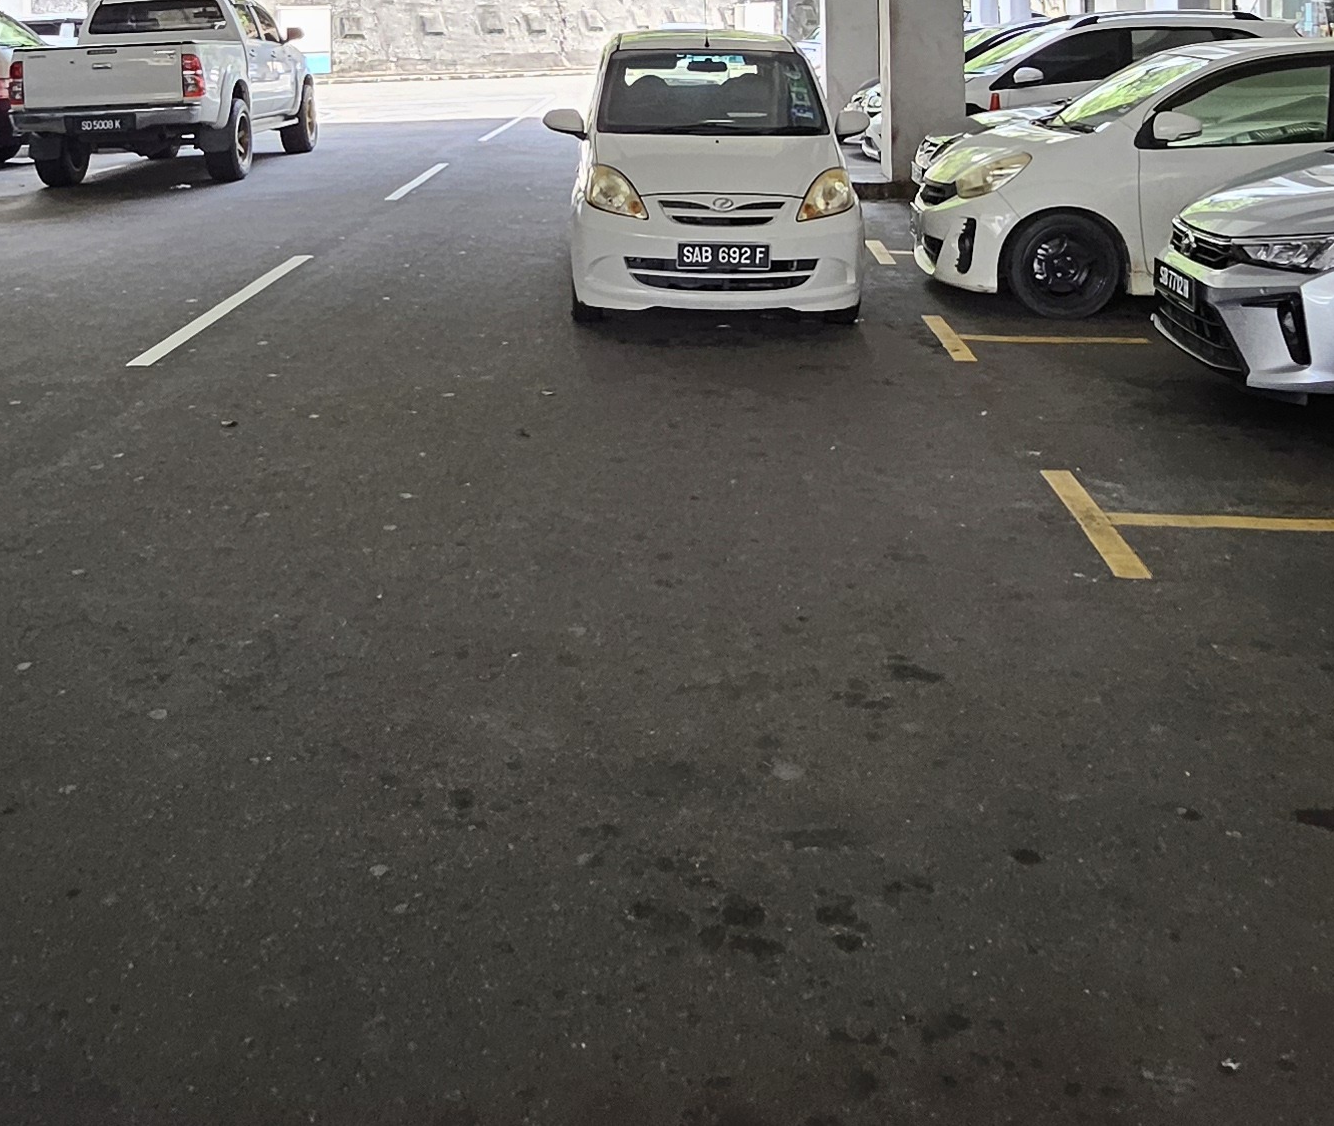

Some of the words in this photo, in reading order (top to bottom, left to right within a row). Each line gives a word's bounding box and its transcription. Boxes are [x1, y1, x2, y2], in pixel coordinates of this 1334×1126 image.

[683, 246, 712, 263] SAB
[718, 247, 751, 264] 692
[755, 247, 765, 264] F
